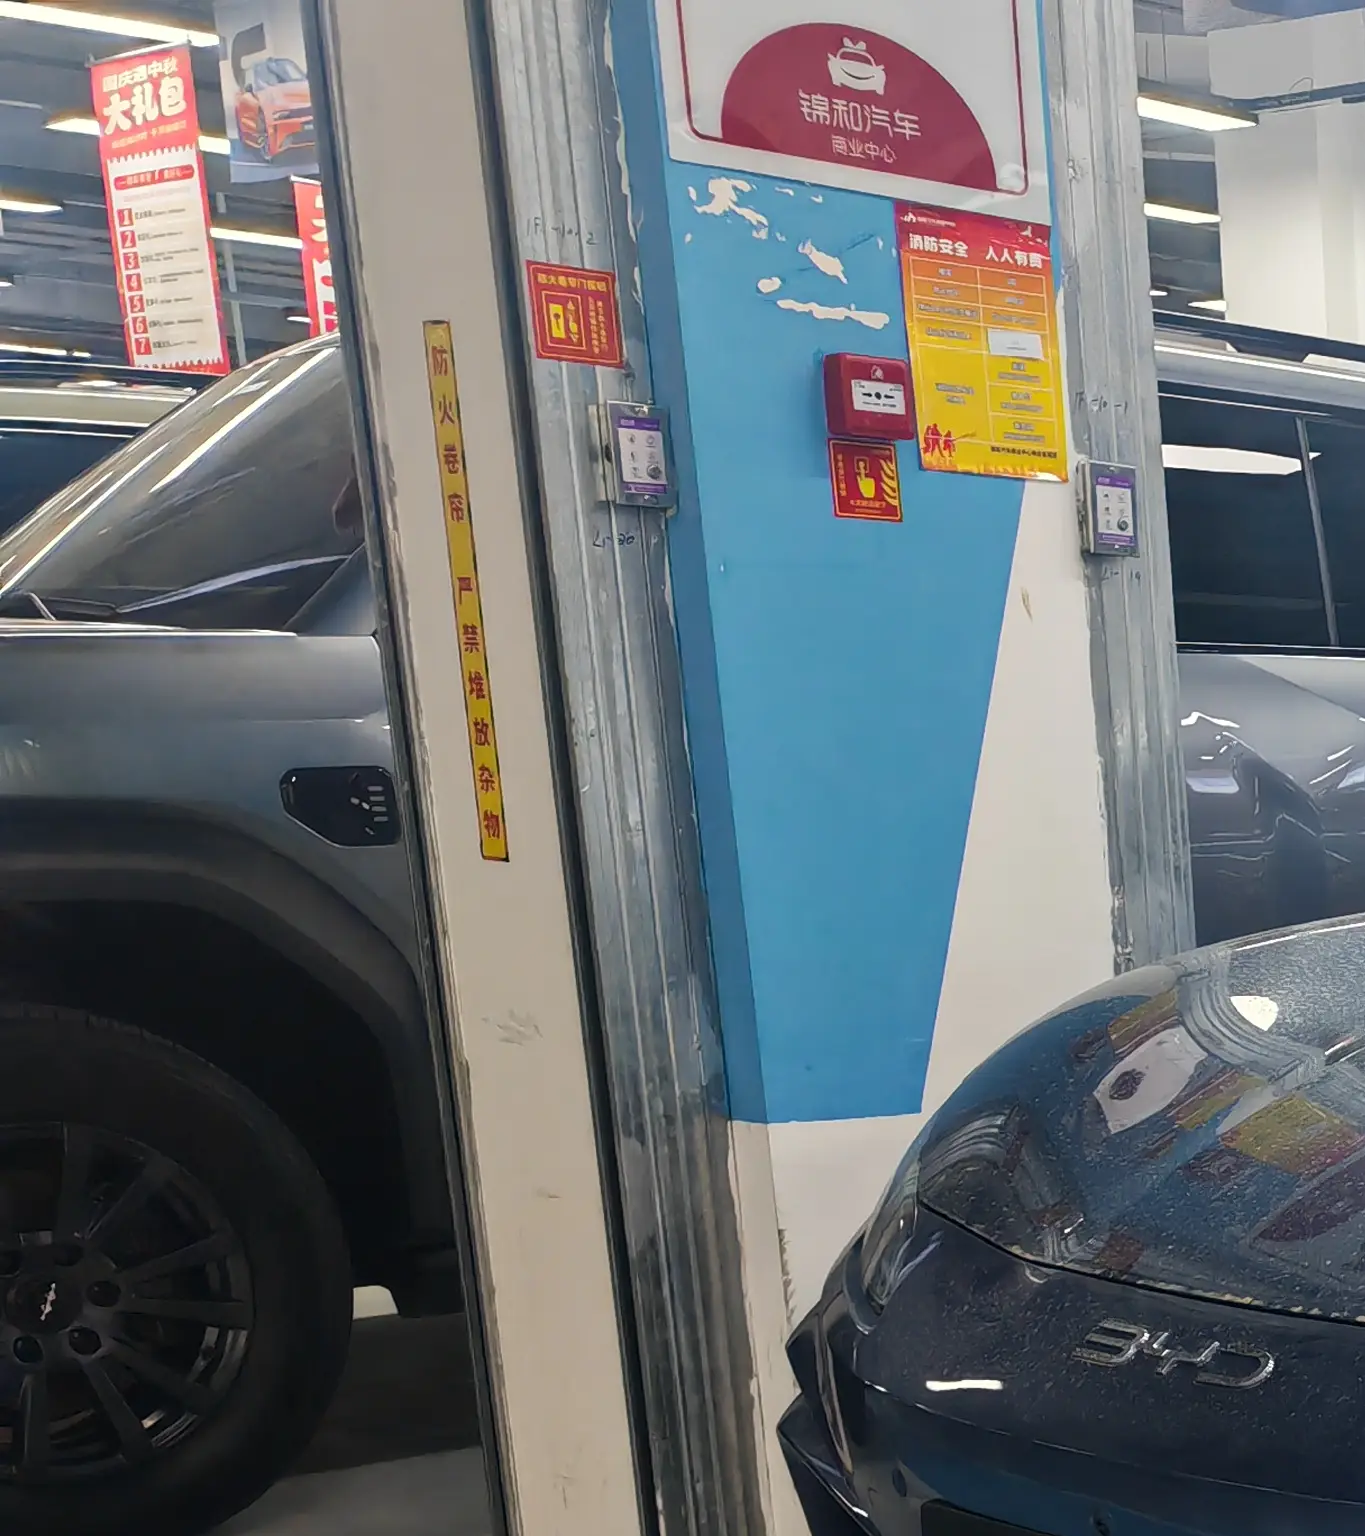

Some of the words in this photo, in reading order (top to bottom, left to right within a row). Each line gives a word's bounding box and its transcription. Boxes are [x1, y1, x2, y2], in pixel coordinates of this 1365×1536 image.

[103, 76, 186, 135] 大礼包
[798, 88, 921, 140] 锦和汽车
[831, 134, 897, 163] 商业中心
[909, 234, 968, 258] 消防安全
[985, 246, 1043, 269] 人人有责
[431, 346, 465, 523] 防火卷帘
[457, 576, 501, 840] 严禁堆放杂物
[1071, 1318, 1274, 1390] BYD
